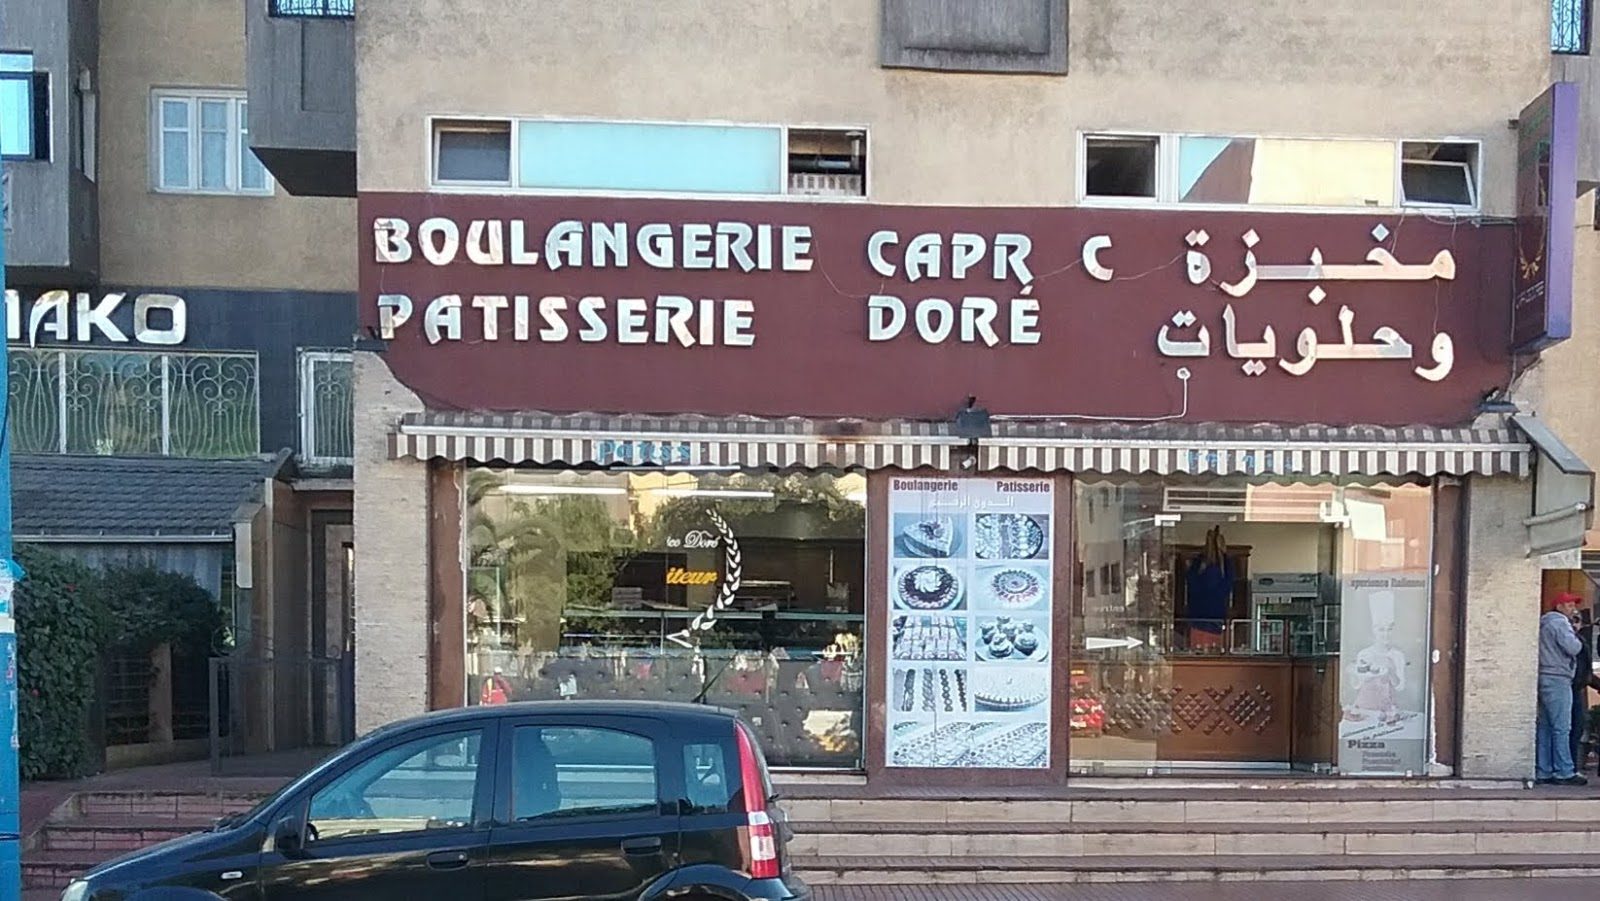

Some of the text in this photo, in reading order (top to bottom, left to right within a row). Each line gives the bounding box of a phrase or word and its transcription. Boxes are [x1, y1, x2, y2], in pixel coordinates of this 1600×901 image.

[374, 217, 814, 273] BOULANGERIE
[1184, 222, 1457, 304] مخبزة
[376, 284, 1042, 348] PATISSERIE DORÉ
[1157, 303, 1455, 382] وحلويات
[892, 479, 1051, 493] Boulangerie Patisserie
[666, 566, 718, 585] iteur
[1347, 738, 1385, 749] Pizza
